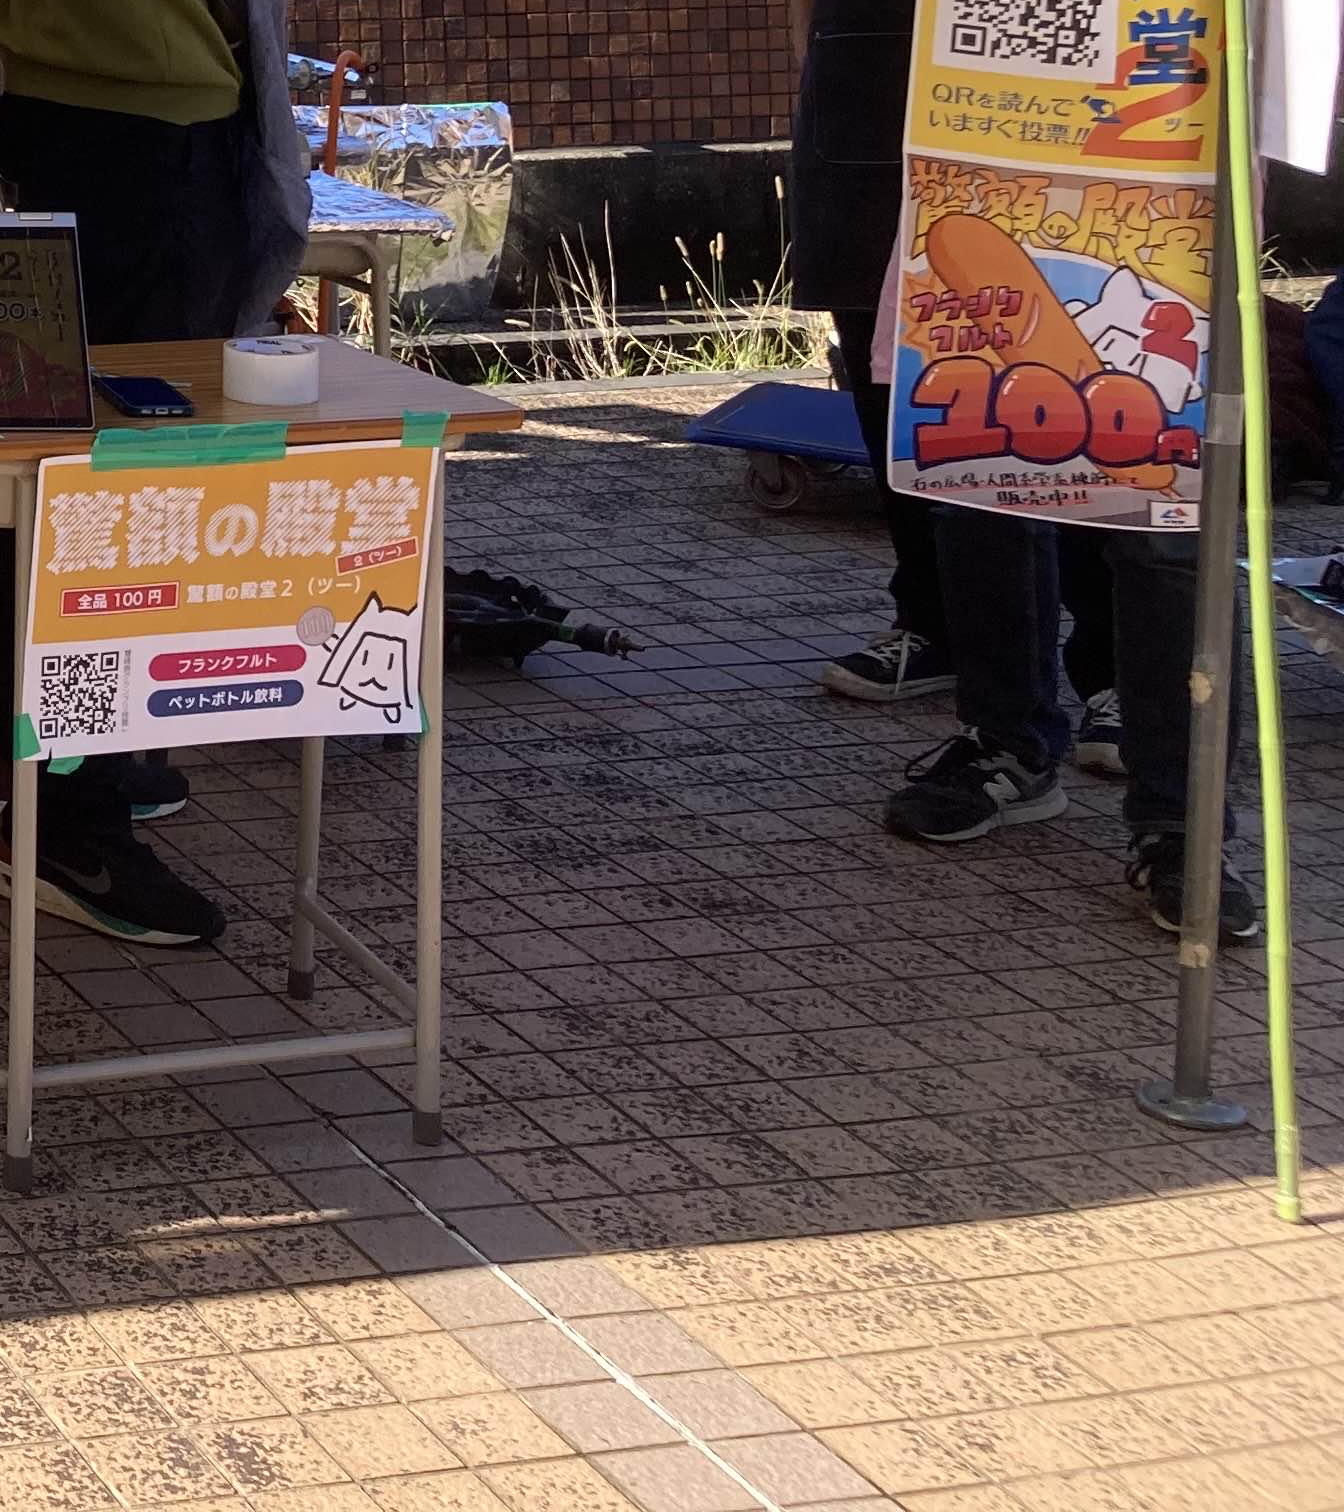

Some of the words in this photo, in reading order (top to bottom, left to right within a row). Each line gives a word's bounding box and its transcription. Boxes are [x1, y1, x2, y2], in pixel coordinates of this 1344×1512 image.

[931, 82, 1075, 117] QRを読んで
[928, 321, 1012, 352] フルト
[77, 593, 108, 611] 全品
[114, 591, 144, 608] 100
[148, 589, 162, 606] 円
[178, 652, 277, 674] フランクフルト
[168, 686, 284, 710] ペットボトル飲料
